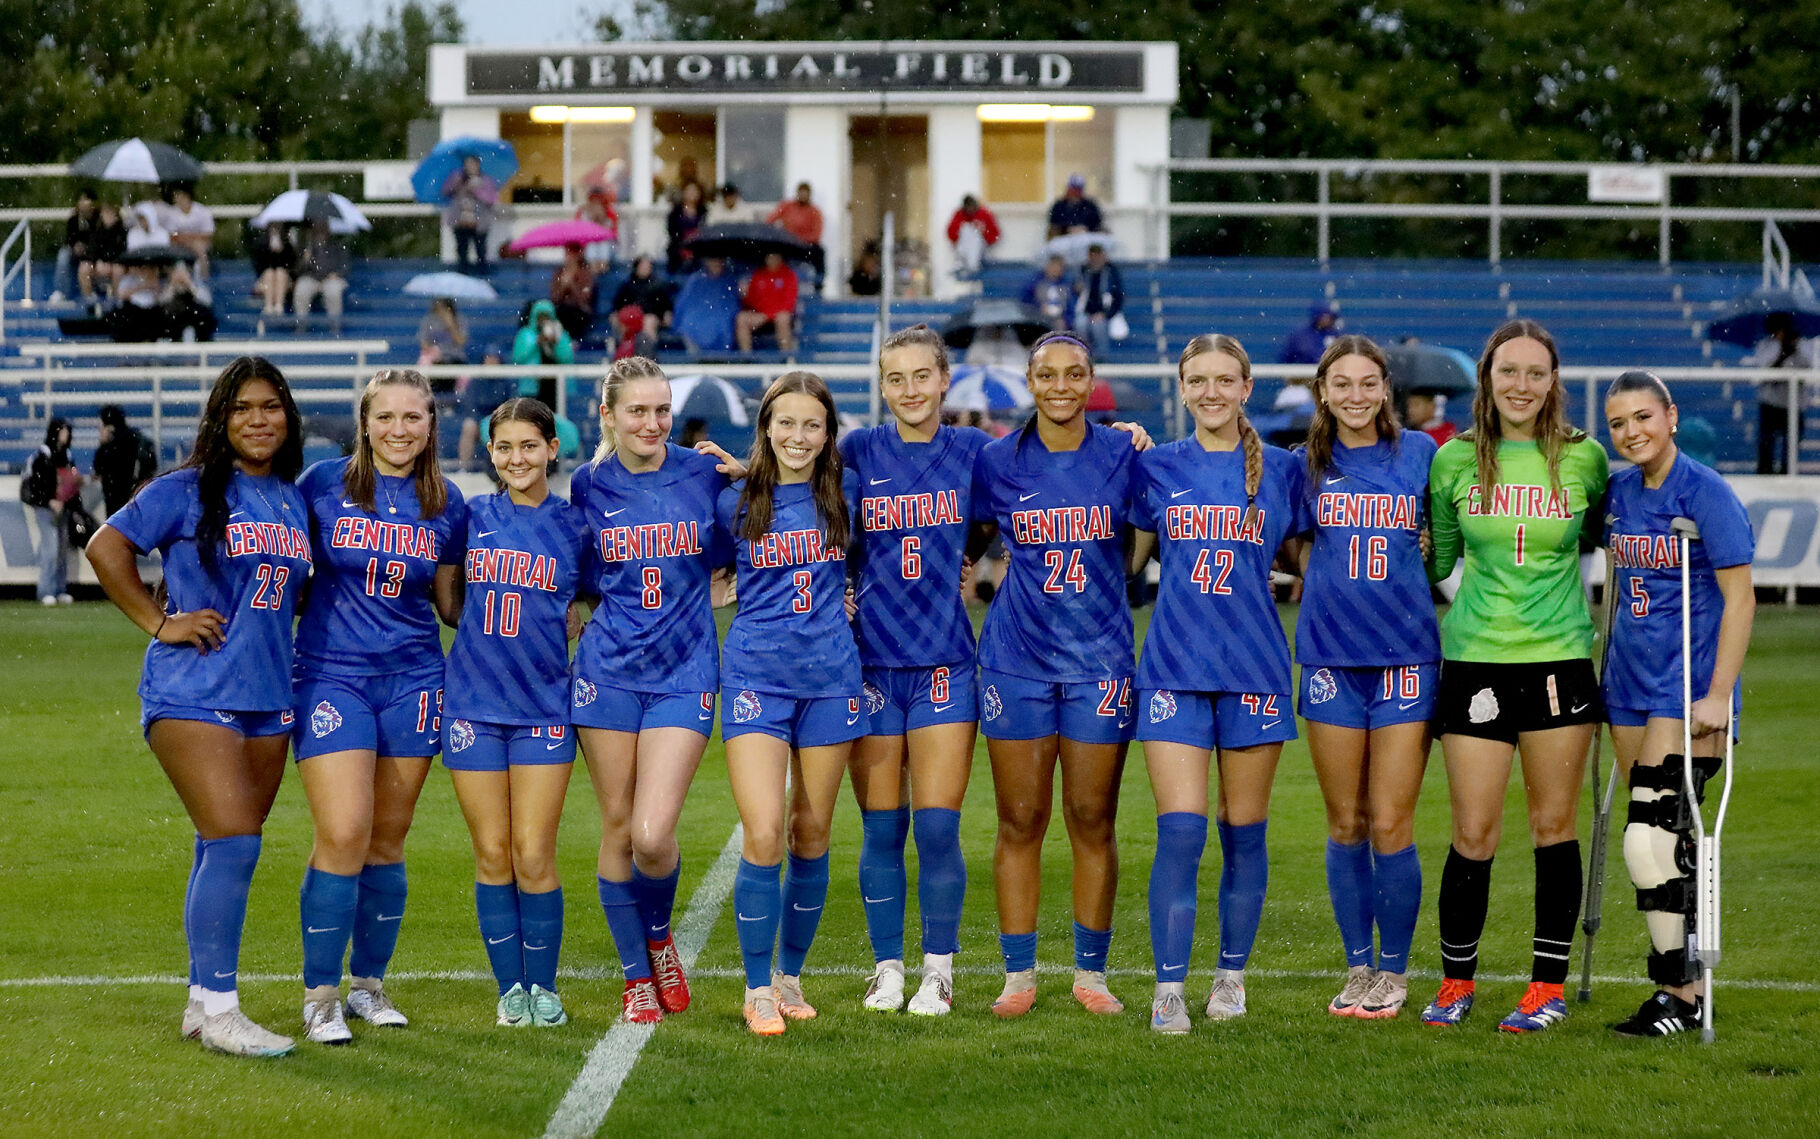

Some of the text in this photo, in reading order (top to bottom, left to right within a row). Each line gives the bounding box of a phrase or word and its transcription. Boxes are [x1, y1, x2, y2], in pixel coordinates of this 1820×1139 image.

[537, 53, 1072, 91] MEMORIAL FIELD
[862, 489, 963, 532] CENTRAL
[1317, 492, 1417, 531] CENTRAL
[1467, 483, 1574, 519] CNTRAL
[225, 521, 312, 564] CENTRAL
[332, 516, 438, 562] CENTRAL
[601, 521, 702, 563] CENTRAL
[1012, 505, 1114, 544] CENTRAL
[1166, 505, 1266, 545] CENTRAL
[1515, 523, 1525, 566] 1
[365, 557, 406, 598] 13
[465, 548, 558, 592] CENTRAL
[901, 536, 921, 580] 6
[1044, 549, 1087, 593] 24
[1191, 549, 1235, 595] 42
[1349, 534, 1388, 581] 16
[251, 563, 290, 610] 23
[641, 567, 662, 609] 8
[792, 570, 812, 614] 3
[1629, 576, 1651, 618] 5
[483, 590, 521, 638] 10
[930, 666, 950, 704] 6
[1546, 674, 1561, 717] 1
